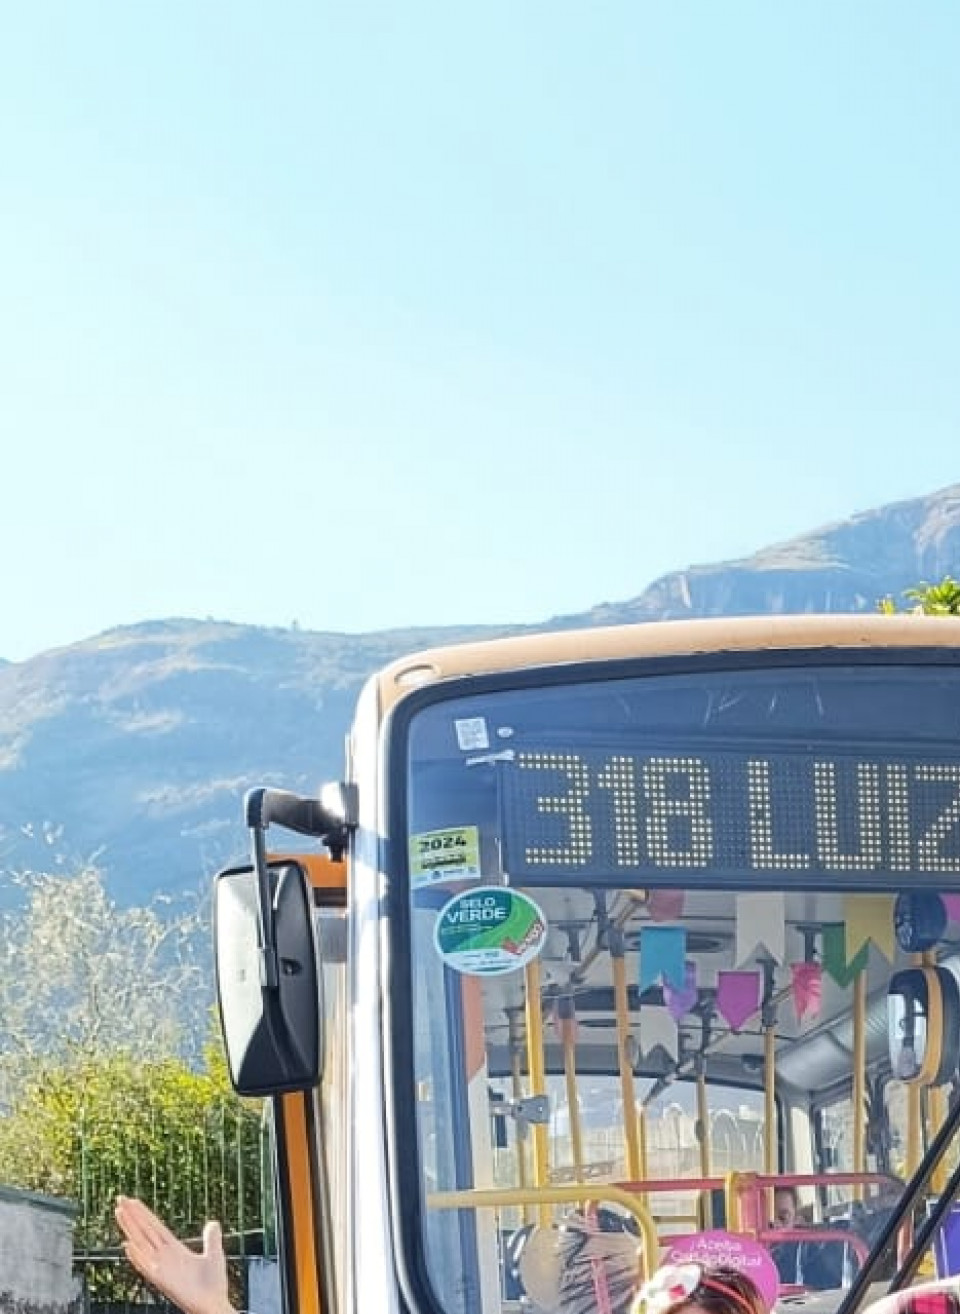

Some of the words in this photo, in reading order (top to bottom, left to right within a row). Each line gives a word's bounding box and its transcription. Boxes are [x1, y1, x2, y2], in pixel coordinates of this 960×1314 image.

[518, 752, 713, 868] 318
[418, 837, 467, 852] 2024
[446, 908, 507, 922] VERDE
